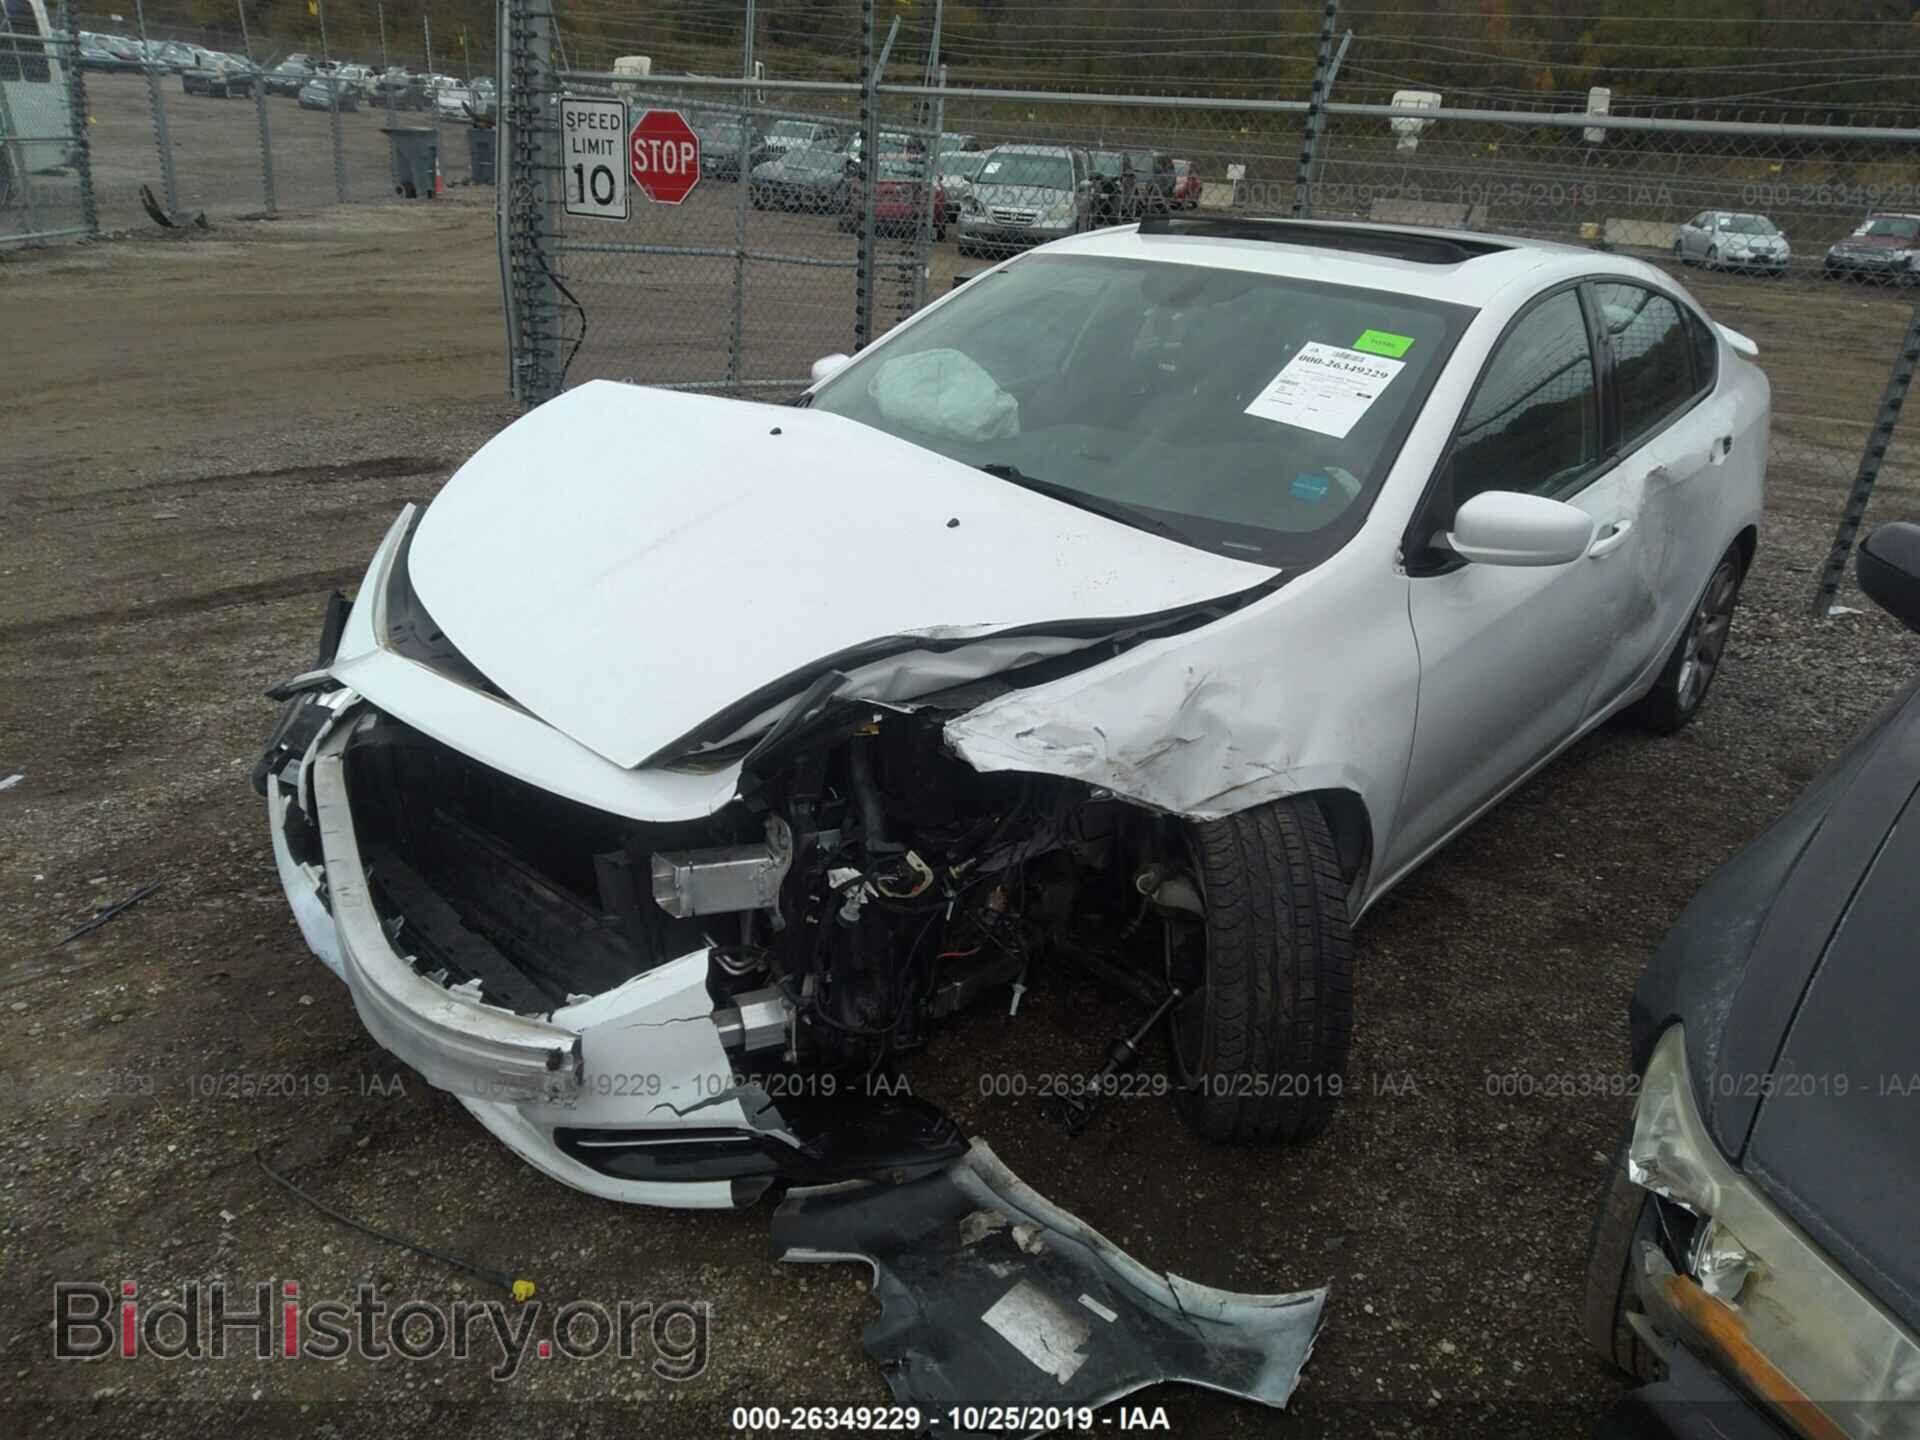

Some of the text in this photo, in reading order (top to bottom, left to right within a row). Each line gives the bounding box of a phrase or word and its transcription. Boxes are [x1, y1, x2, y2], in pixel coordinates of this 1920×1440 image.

[566, 111, 621, 130] SPEED
[572, 138, 614, 156] LIMIT
[634, 138, 695, 175] STOP
[573, 163, 615, 206] 10
